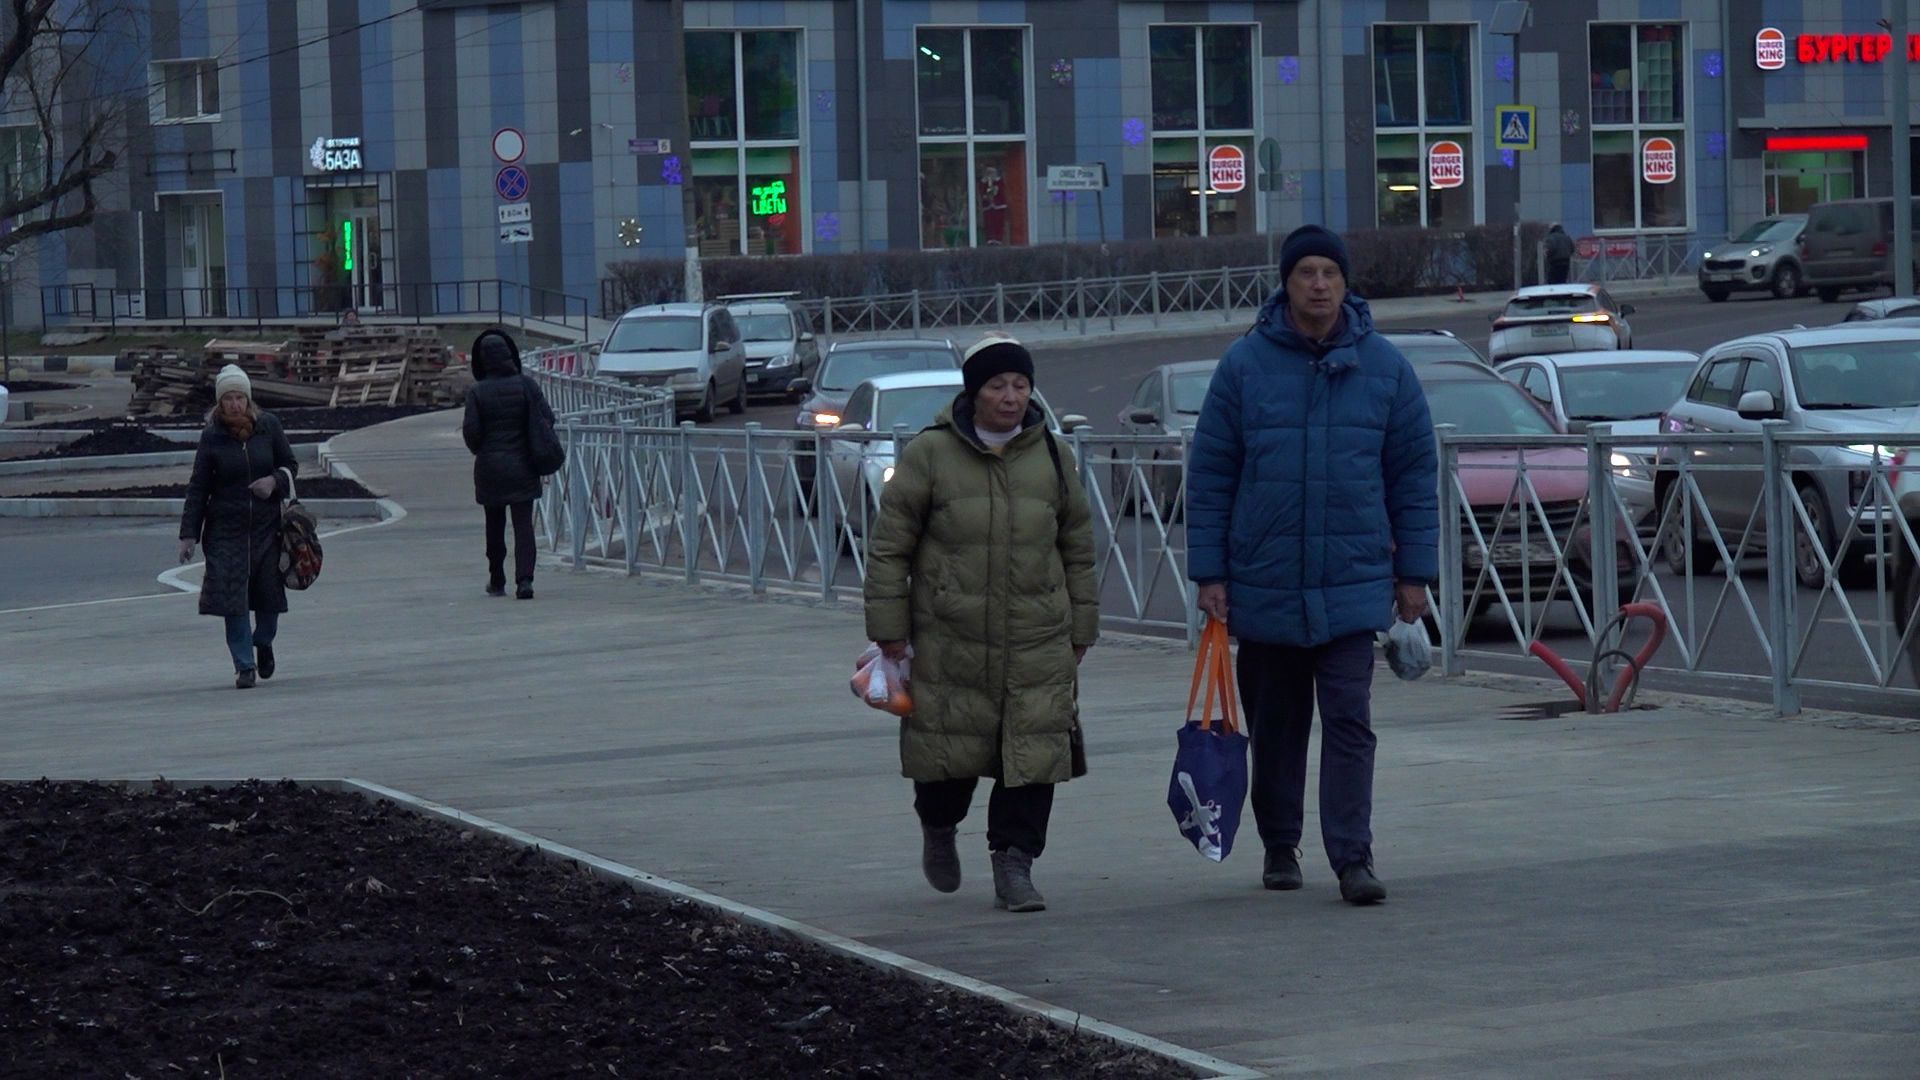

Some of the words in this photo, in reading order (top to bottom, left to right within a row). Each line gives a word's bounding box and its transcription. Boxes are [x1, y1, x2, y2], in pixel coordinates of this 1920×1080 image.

[1797, 33, 1892, 63] БУРГЕР
[1758, 49, 1783, 60] KING
[325, 149, 362, 170] БАЗА
[1431, 155, 1461, 164] BURGER
[1646, 152, 1673, 160] BURGER
[1212, 160, 1242, 168] BURGER
[1646, 161, 1674, 173] KING
[1212, 169, 1243, 181] KING
[1431, 164, 1462, 177] KING
